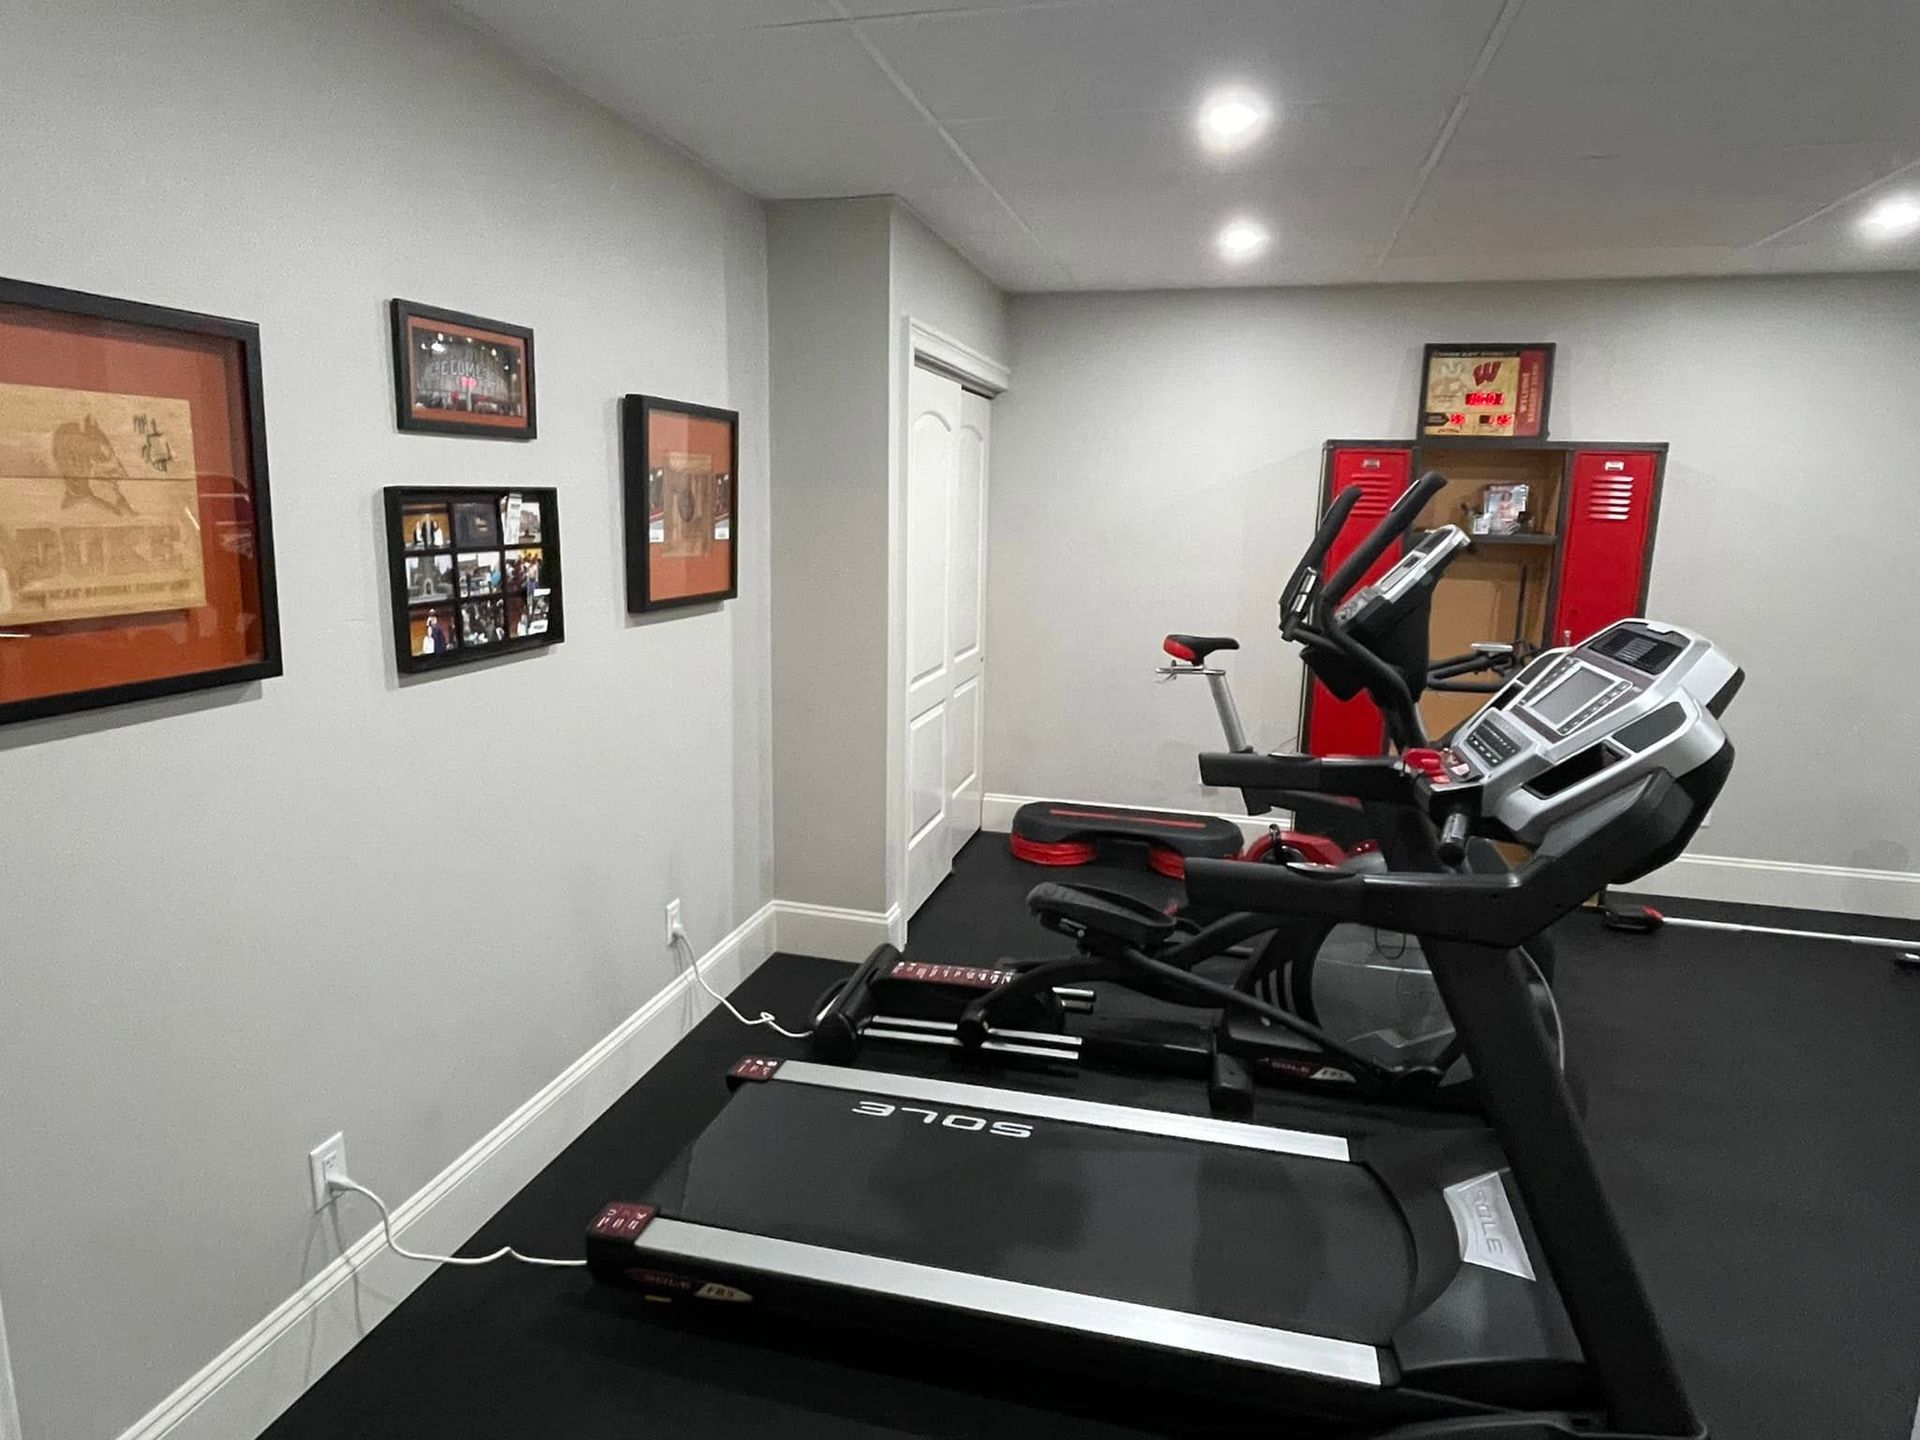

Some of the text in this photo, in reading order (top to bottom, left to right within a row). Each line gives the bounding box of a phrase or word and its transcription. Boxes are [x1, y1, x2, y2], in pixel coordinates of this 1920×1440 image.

[1473, 360, 1502, 387] W
[852, 1101, 1035, 1139] SOLE
[1475, 1189, 1504, 1254] SOLE
